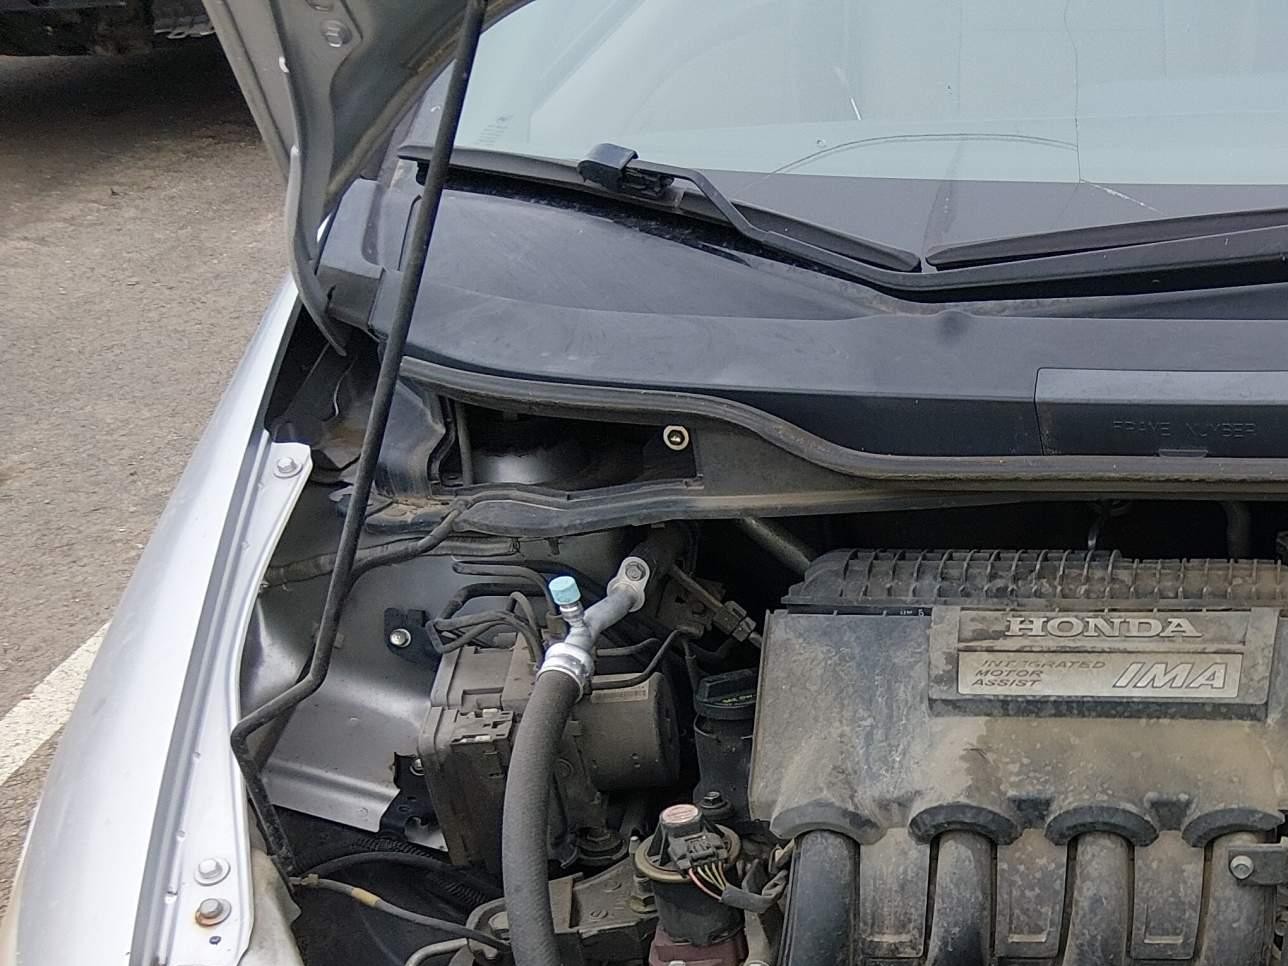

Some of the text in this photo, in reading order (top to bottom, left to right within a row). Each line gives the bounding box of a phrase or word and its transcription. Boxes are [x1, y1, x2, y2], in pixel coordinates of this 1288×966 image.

[1112, 420, 1257, 438] FRAME NUMBER
[1005, 617, 1202, 638] HONDA
[971, 678, 1042, 687] ASSIST
[975, 669, 1044, 678] MOTOR
[1112, 661, 1228, 690] IMA
